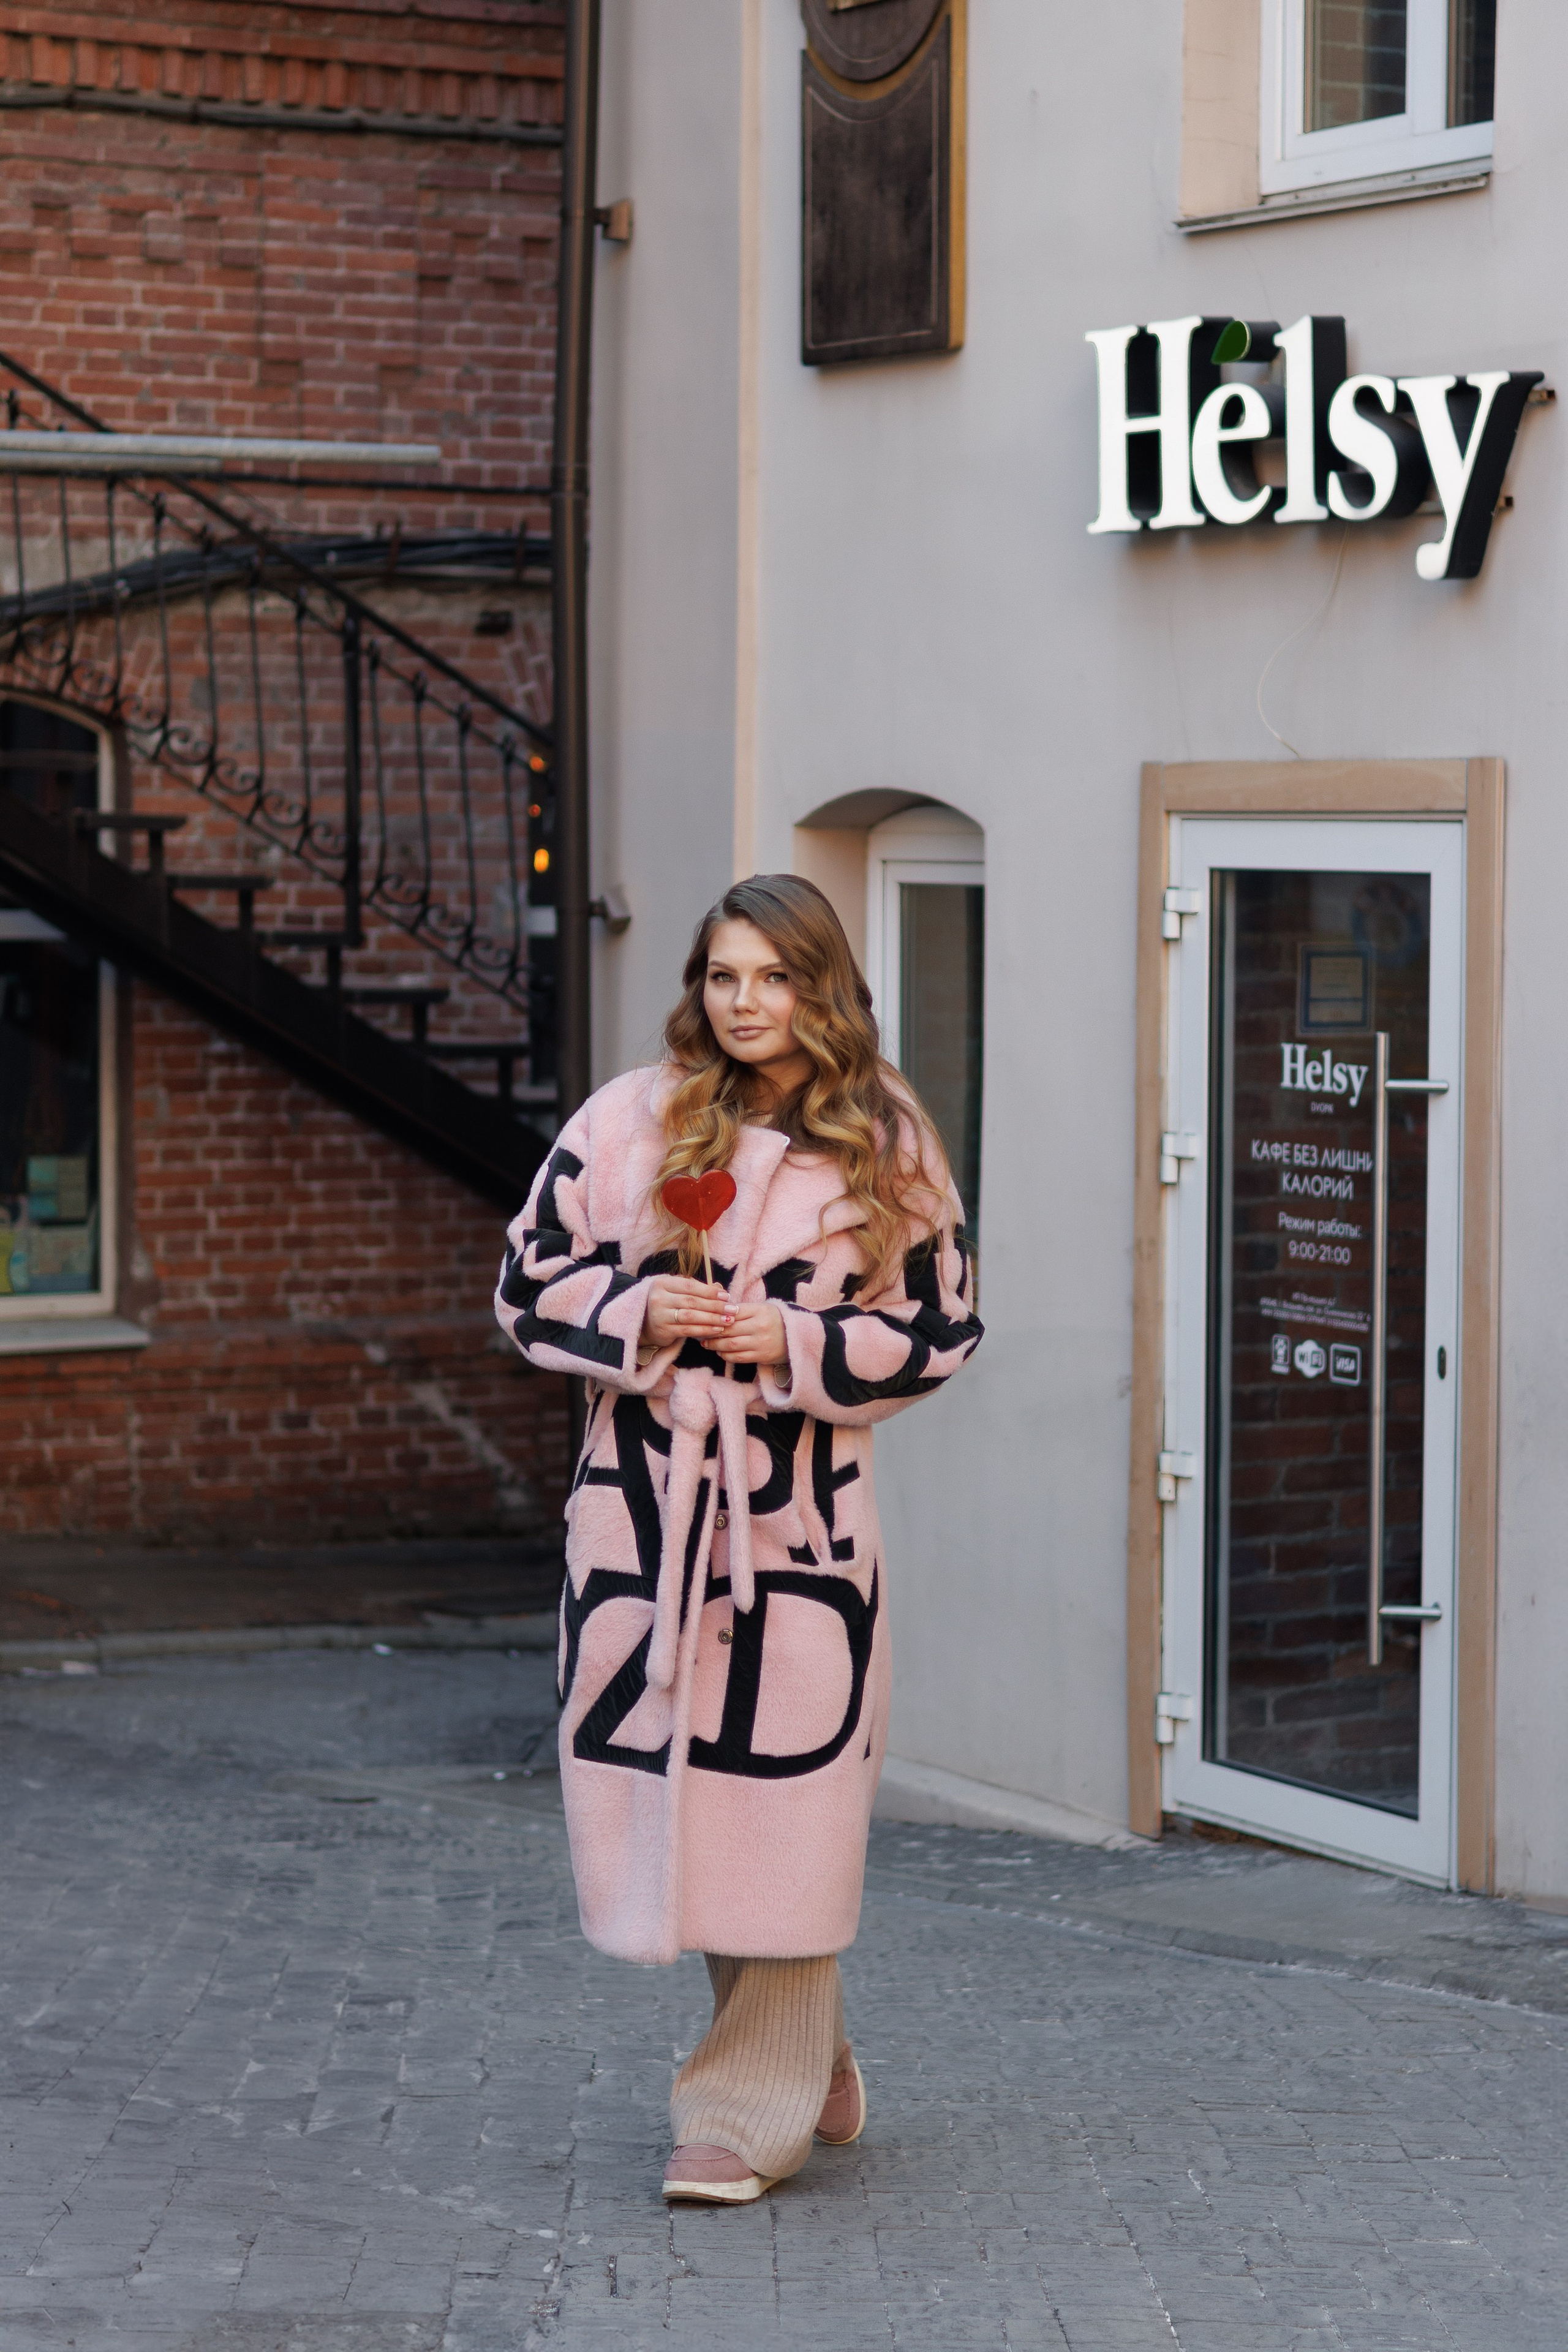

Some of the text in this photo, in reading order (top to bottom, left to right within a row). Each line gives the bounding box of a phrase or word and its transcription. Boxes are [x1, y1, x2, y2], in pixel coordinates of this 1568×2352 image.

[1085, 315, 1511, 581] Helsy
[1281, 1042, 1368, 1107] Helsy
[1251, 1139, 1291, 1163] КАФЕ
[1294, 1143, 1317, 1166] БЕЗ
[1282, 1172, 1353, 1200] КАЛОРИЙ
[1279, 1212, 1361, 1237] Режим работы:
[1289, 1240, 1350, 1264] 9:00-21:00
[1336, 1356, 1355, 1372] VISA
